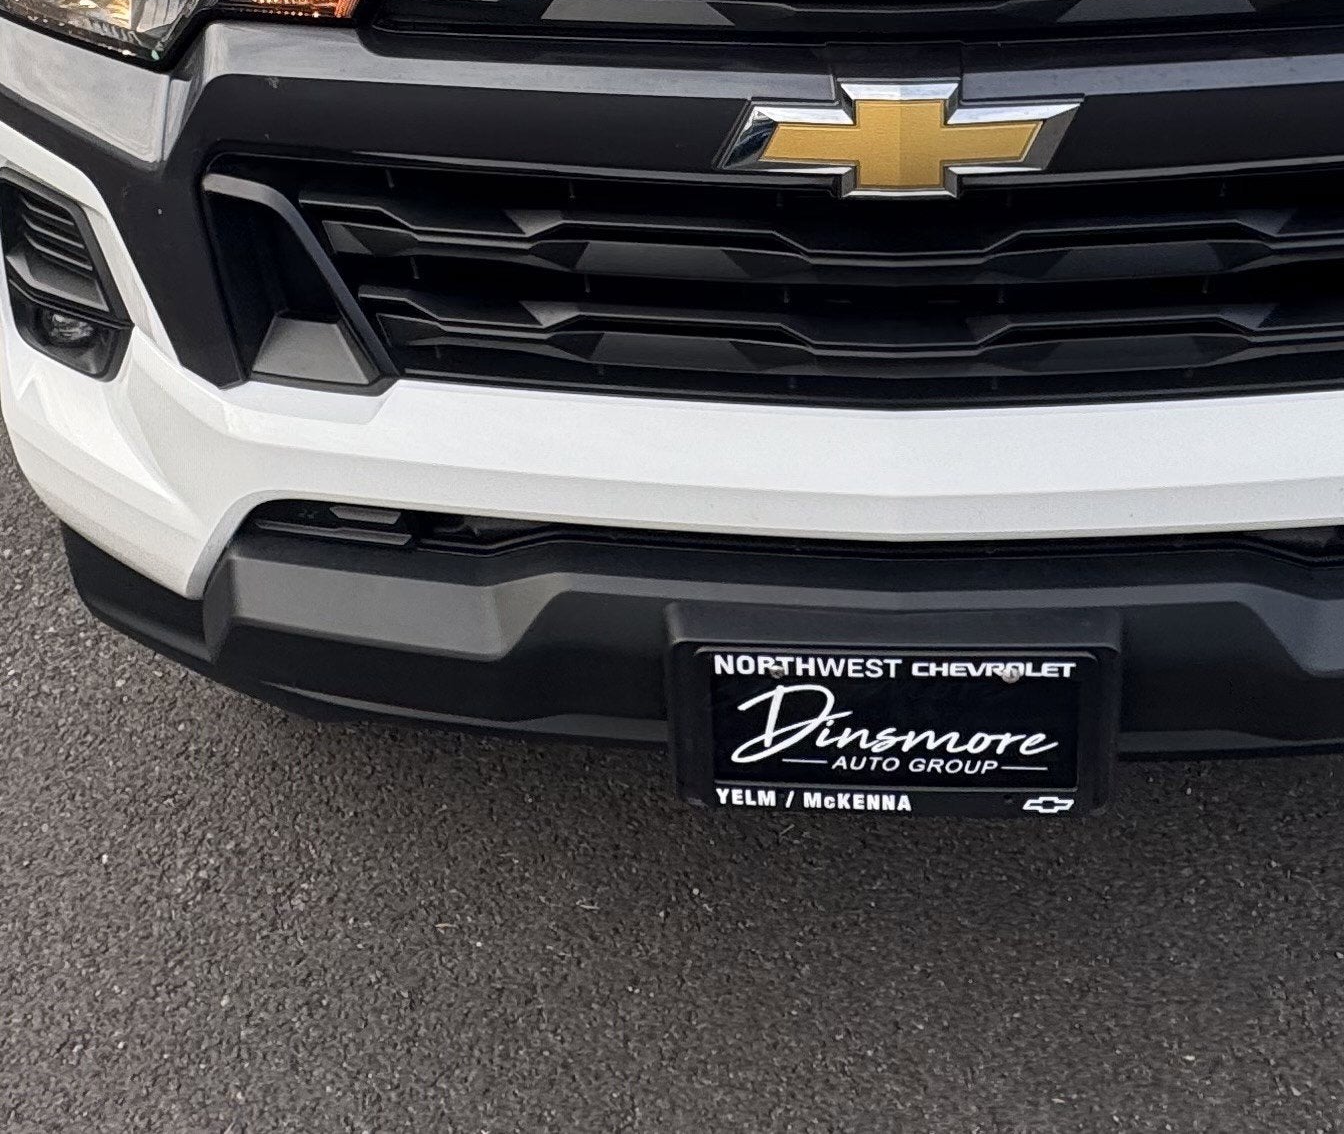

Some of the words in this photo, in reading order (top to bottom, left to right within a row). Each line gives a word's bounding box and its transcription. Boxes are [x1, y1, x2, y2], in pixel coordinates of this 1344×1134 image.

[713, 654, 903, 679] NORTHWEST
[911, 661, 1077, 678] CHEVROLET
[730, 683, 1059, 764] Dinsmore
[831, 754, 901, 773] AUTO
[908, 757, 999, 775] GROUP
[714, 787, 778, 808] YELM
[802, 791, 913, 812] McKENNA
